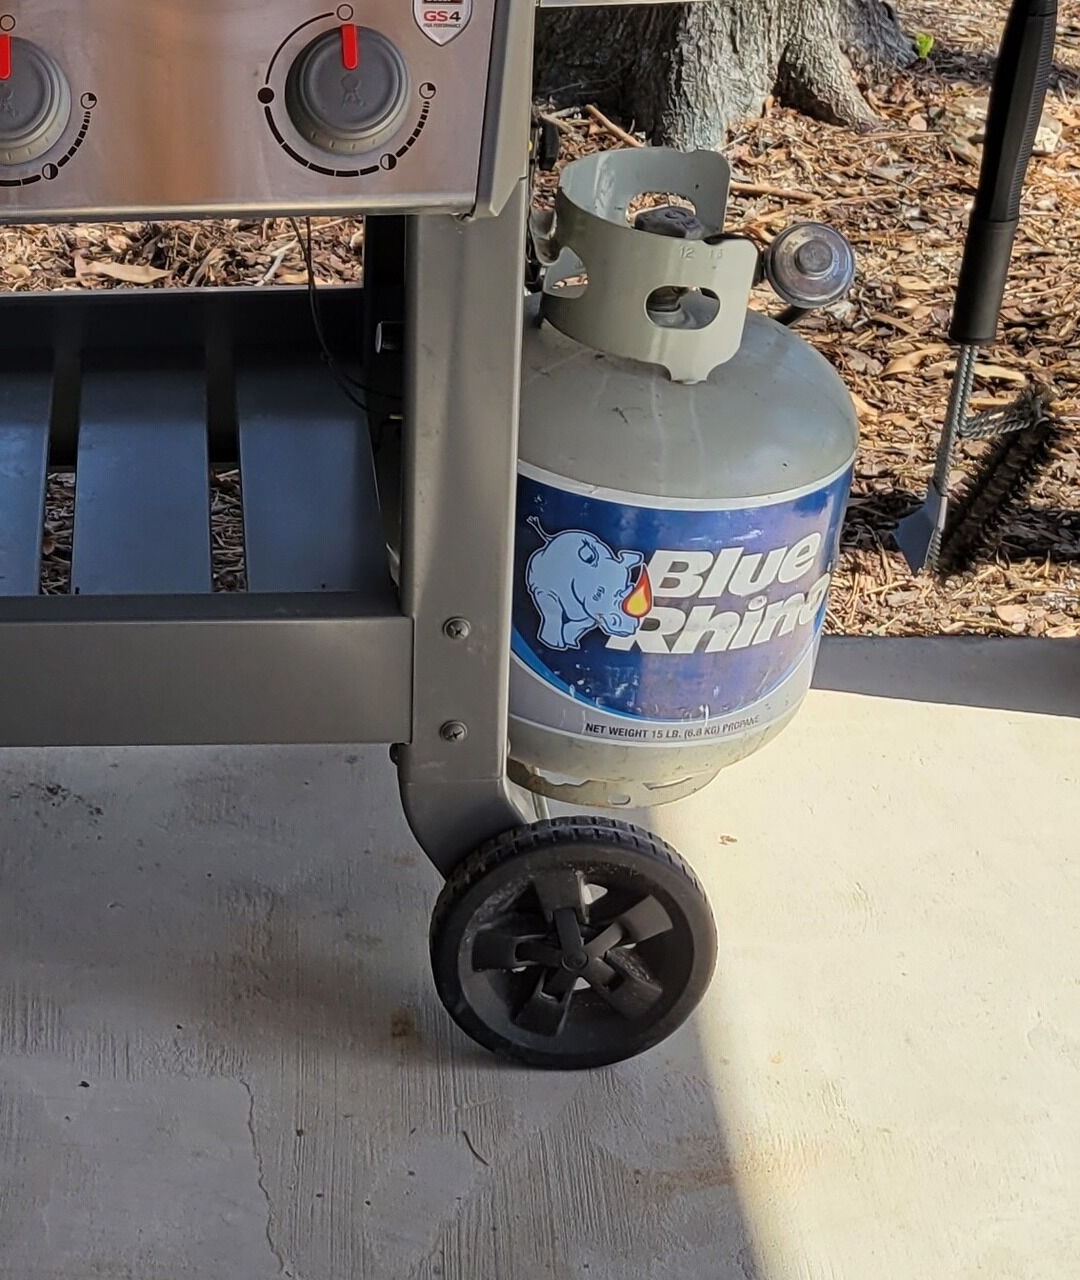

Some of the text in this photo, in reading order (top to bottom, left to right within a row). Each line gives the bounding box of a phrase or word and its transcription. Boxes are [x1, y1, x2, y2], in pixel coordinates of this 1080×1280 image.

[424, 10, 461, 22] GS4
[649, 532, 821, 599] Blue
[605, 573, 831, 654] Rhino
[585, 722, 606, 734] NET
[608, 726, 648, 739] WEIGHT
[652, 729, 663, 739] 15
[665, 729, 681, 739] LB.
[704, 726, 720, 736] KG)
